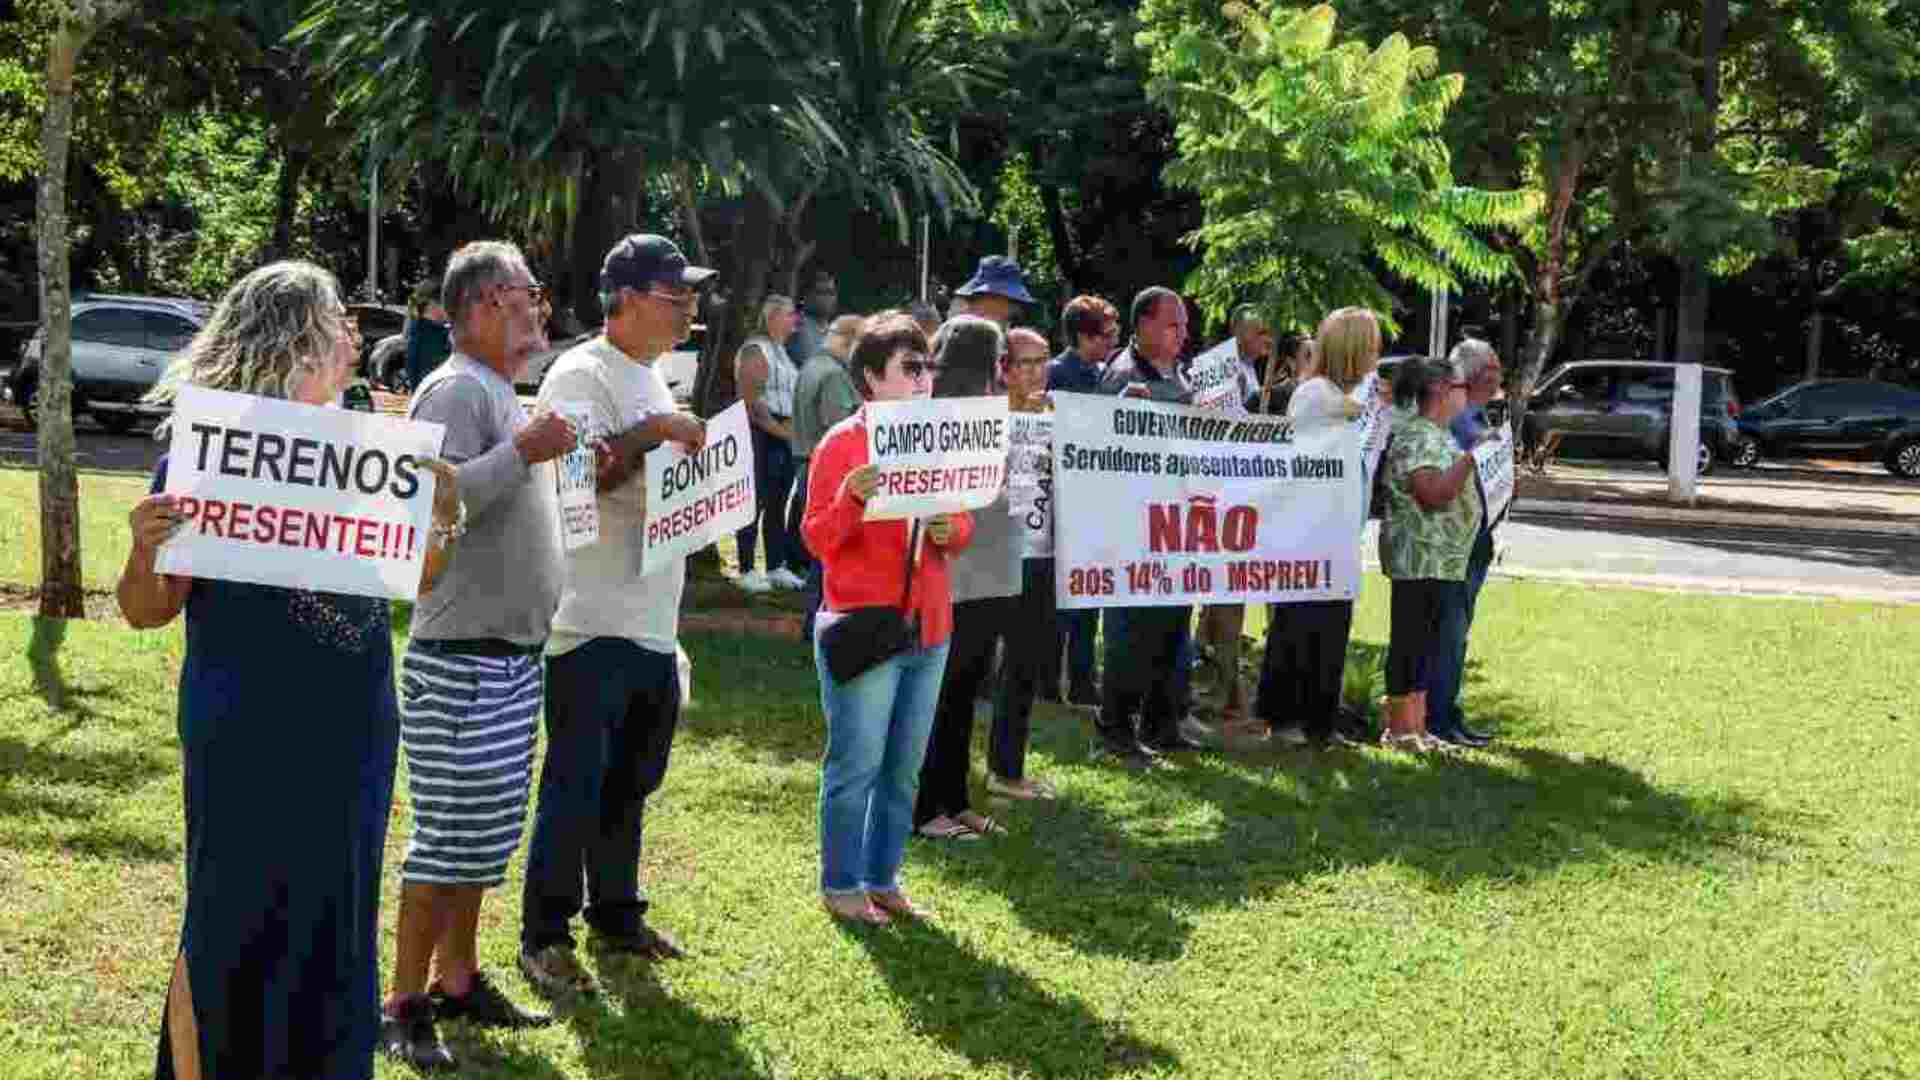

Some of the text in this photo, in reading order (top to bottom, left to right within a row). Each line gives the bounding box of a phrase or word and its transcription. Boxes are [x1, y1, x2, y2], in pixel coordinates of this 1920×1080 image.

[874, 421, 935, 457] CAMPO
[939, 418, 1003, 453] GRANDE
[1113, 408, 1231, 441] GOVERNADOR
[191, 423, 419, 500] TERENOS
[662, 434, 738, 501] BONITO
[1061, 443, 1344, 480] Servidores aposentados dizem
[648, 477, 751, 548] PRESENTE!!!
[1148, 494, 1259, 553] NÃO
[1069, 567, 1114, 597] aos
[1125, 560, 1173, 595] 14%
[1182, 564, 1211, 593] do
